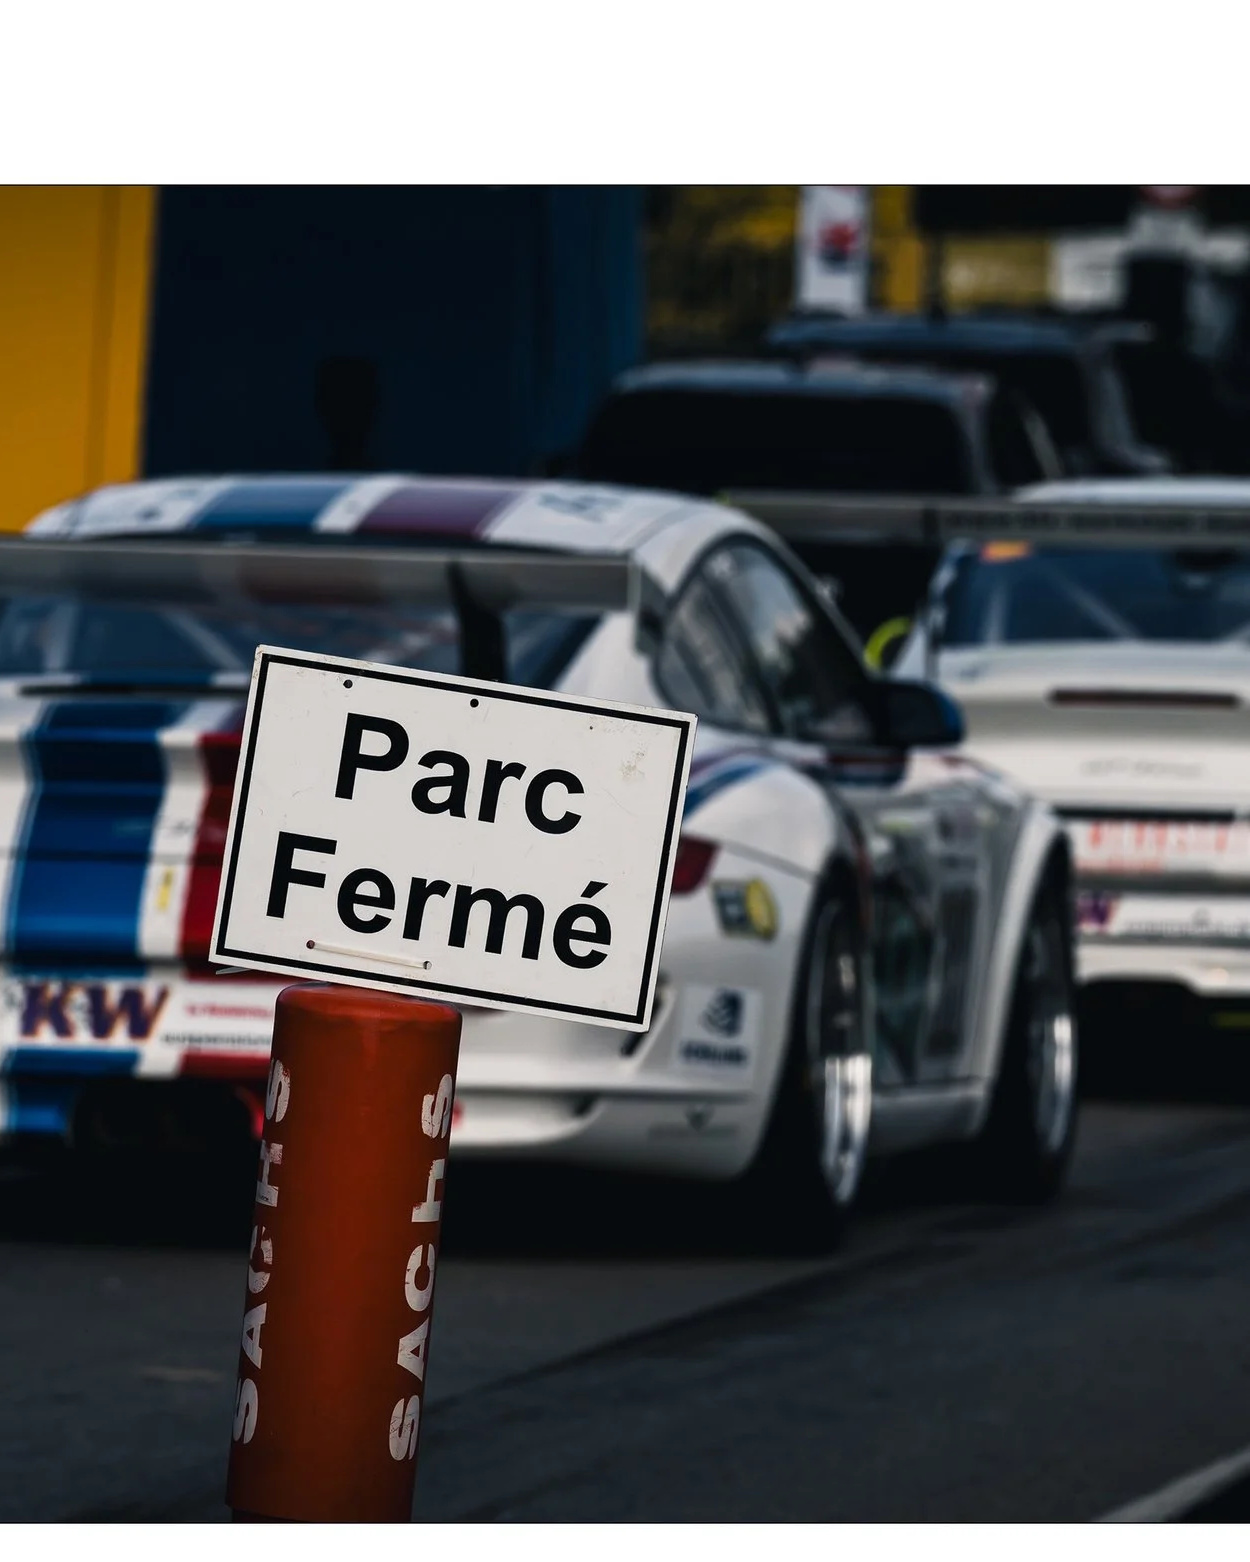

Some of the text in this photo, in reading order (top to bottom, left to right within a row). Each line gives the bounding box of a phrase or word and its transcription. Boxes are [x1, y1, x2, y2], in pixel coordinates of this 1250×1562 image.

[335, 712, 585, 835] Parc
[266, 830, 612, 970] Fermé
[16, 982, 171, 1040] KW
